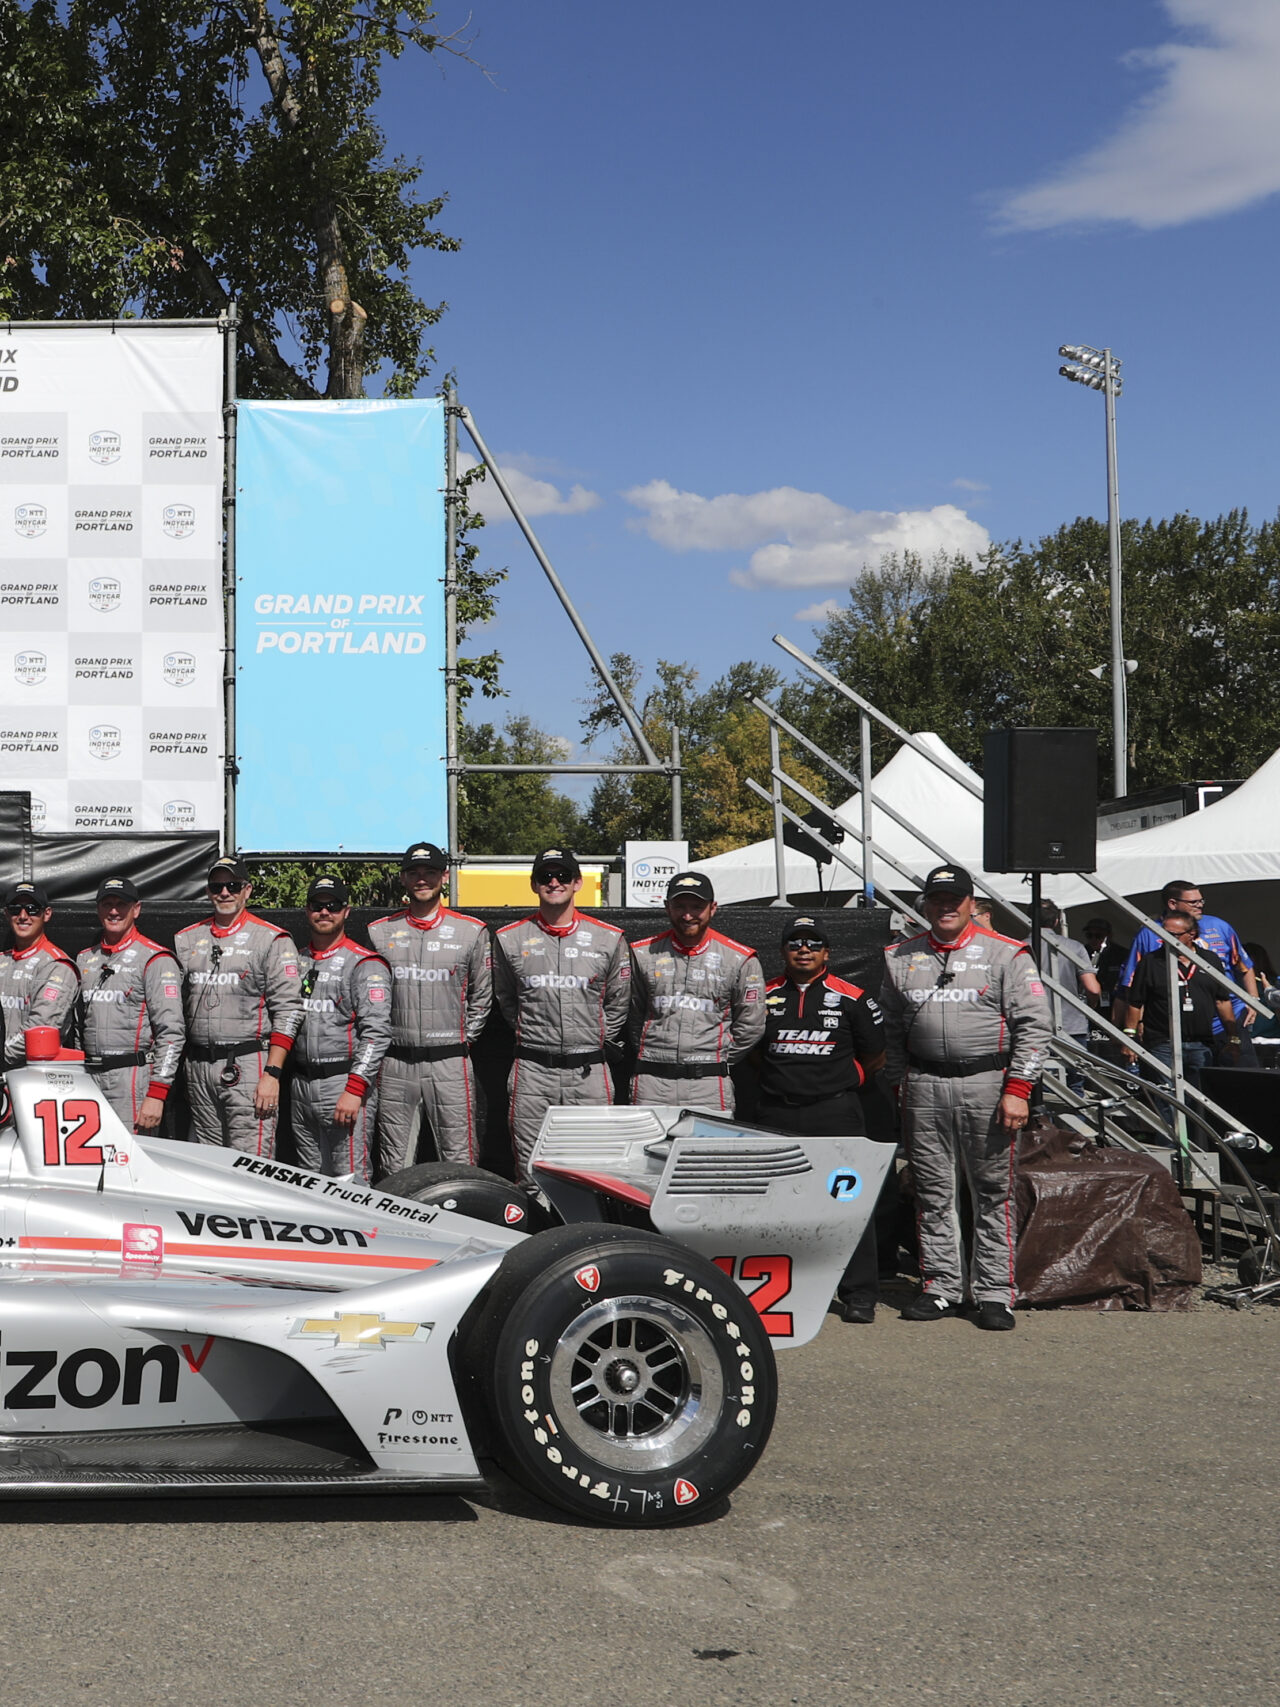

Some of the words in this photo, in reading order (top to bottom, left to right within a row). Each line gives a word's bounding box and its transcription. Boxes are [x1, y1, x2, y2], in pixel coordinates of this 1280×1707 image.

[1, 437, 33, 445] GRAND
[35, 437, 58, 445] PRIX
[149, 437, 181, 445] GRAND
[183, 437, 207, 445] PRIX
[2, 449, 60, 458] PORTLAND
[150, 449, 208, 458] PORTLAND
[75, 510, 107, 518] GRAND
[109, 510, 132, 518] PRIX
[76, 522, 134, 532] PORTLAND
[1, 583, 33, 592] GRAND
[35, 583, 58, 592] PRIX
[149, 584, 181, 592] GRAND
[183, 584, 207, 592] PRIX
[1, 596, 60, 605] PORTLAND
[150, 596, 208, 606] PORTLAND
[254, 594, 353, 614] GRAND
[357, 594, 425, 614] PRIX
[330, 618, 350, 629] OF
[255, 631, 427, 654] PORTLAND
[75, 657, 107, 666] GRAND
[109, 657, 133, 666] PRIX
[76, 670, 134, 679] PORTLAND
[0, 731, 32, 739] GRAND
[34, 731, 58, 739] PRIX
[149, 732, 181, 741] GRAND
[183, 732, 207, 741] PRIX
[1, 743, 59, 752] PORTLAND
[150, 744, 209, 754] PORTLAND
[75, 805, 107, 814] GRAND
[109, 805, 133, 814] PRIX
[75, 818, 134, 828] PORTLAND
[653, 866, 676, 875] NTT
[632, 880, 670, 888] INDYCA
[82, 985, 124, 1003] erizon
[777, 1030, 831, 1041] TEAM
[769, 1042, 835, 1055] PENSKE
[34, 1099, 105, 1166] 12
[232, 1156, 320, 1190] PENSKE
[322, 1181, 372, 1206] Truck
[375, 1198, 439, 1225] Rental
[175, 1209, 369, 1248] verizon
[661, 1267, 758, 1429] Firestone
[430, 1413, 454, 1423] NTT
[519, 1337, 612, 1500] Firestone
[377, 1432, 459, 1445] Firestone
